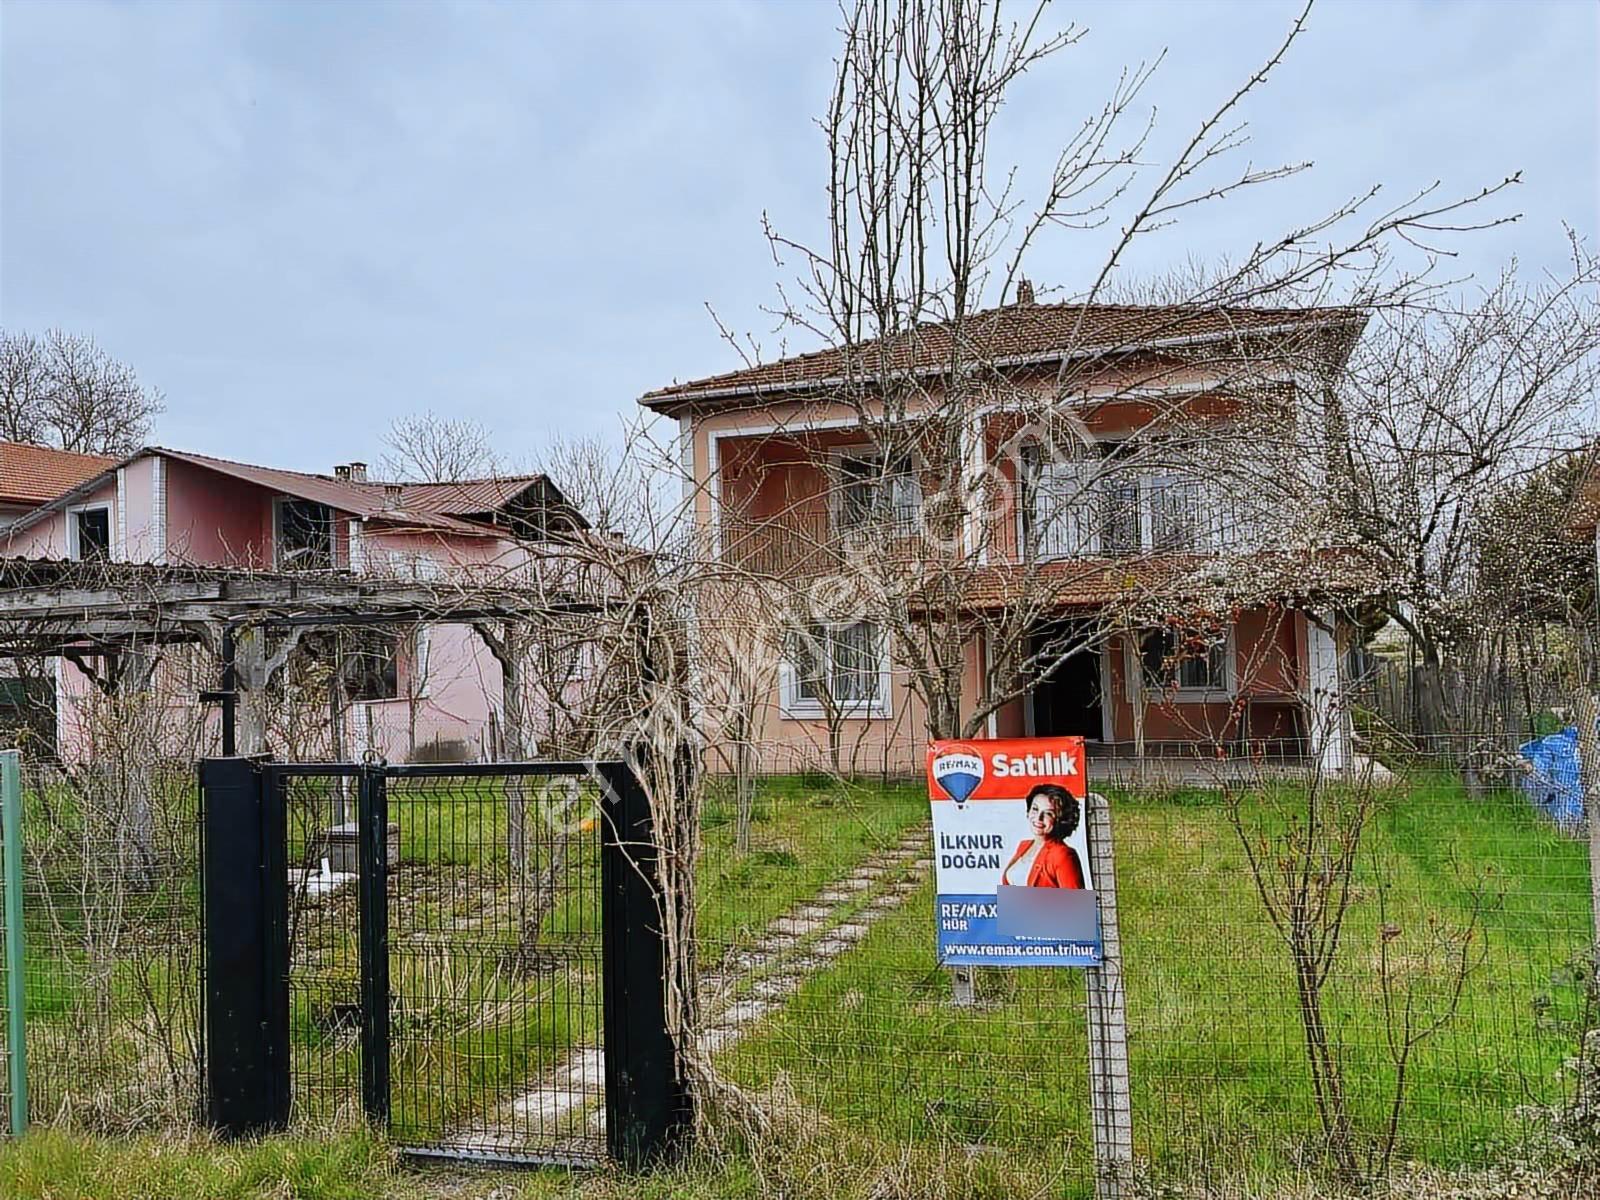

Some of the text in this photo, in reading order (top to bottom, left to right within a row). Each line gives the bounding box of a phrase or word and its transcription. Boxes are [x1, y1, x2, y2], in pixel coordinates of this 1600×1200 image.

[938, 759, 978, 772] RE/MAX
[992, 752, 1078, 777] Satılık
[940, 832, 1003, 849] İLKNUR
[942, 851, 1000, 869] DOĞAN
[941, 903, 997, 918] RE/MAX
[942, 918, 969, 931] HÜR
[944, 944, 1095, 957] www.remax.com.tr/hur
